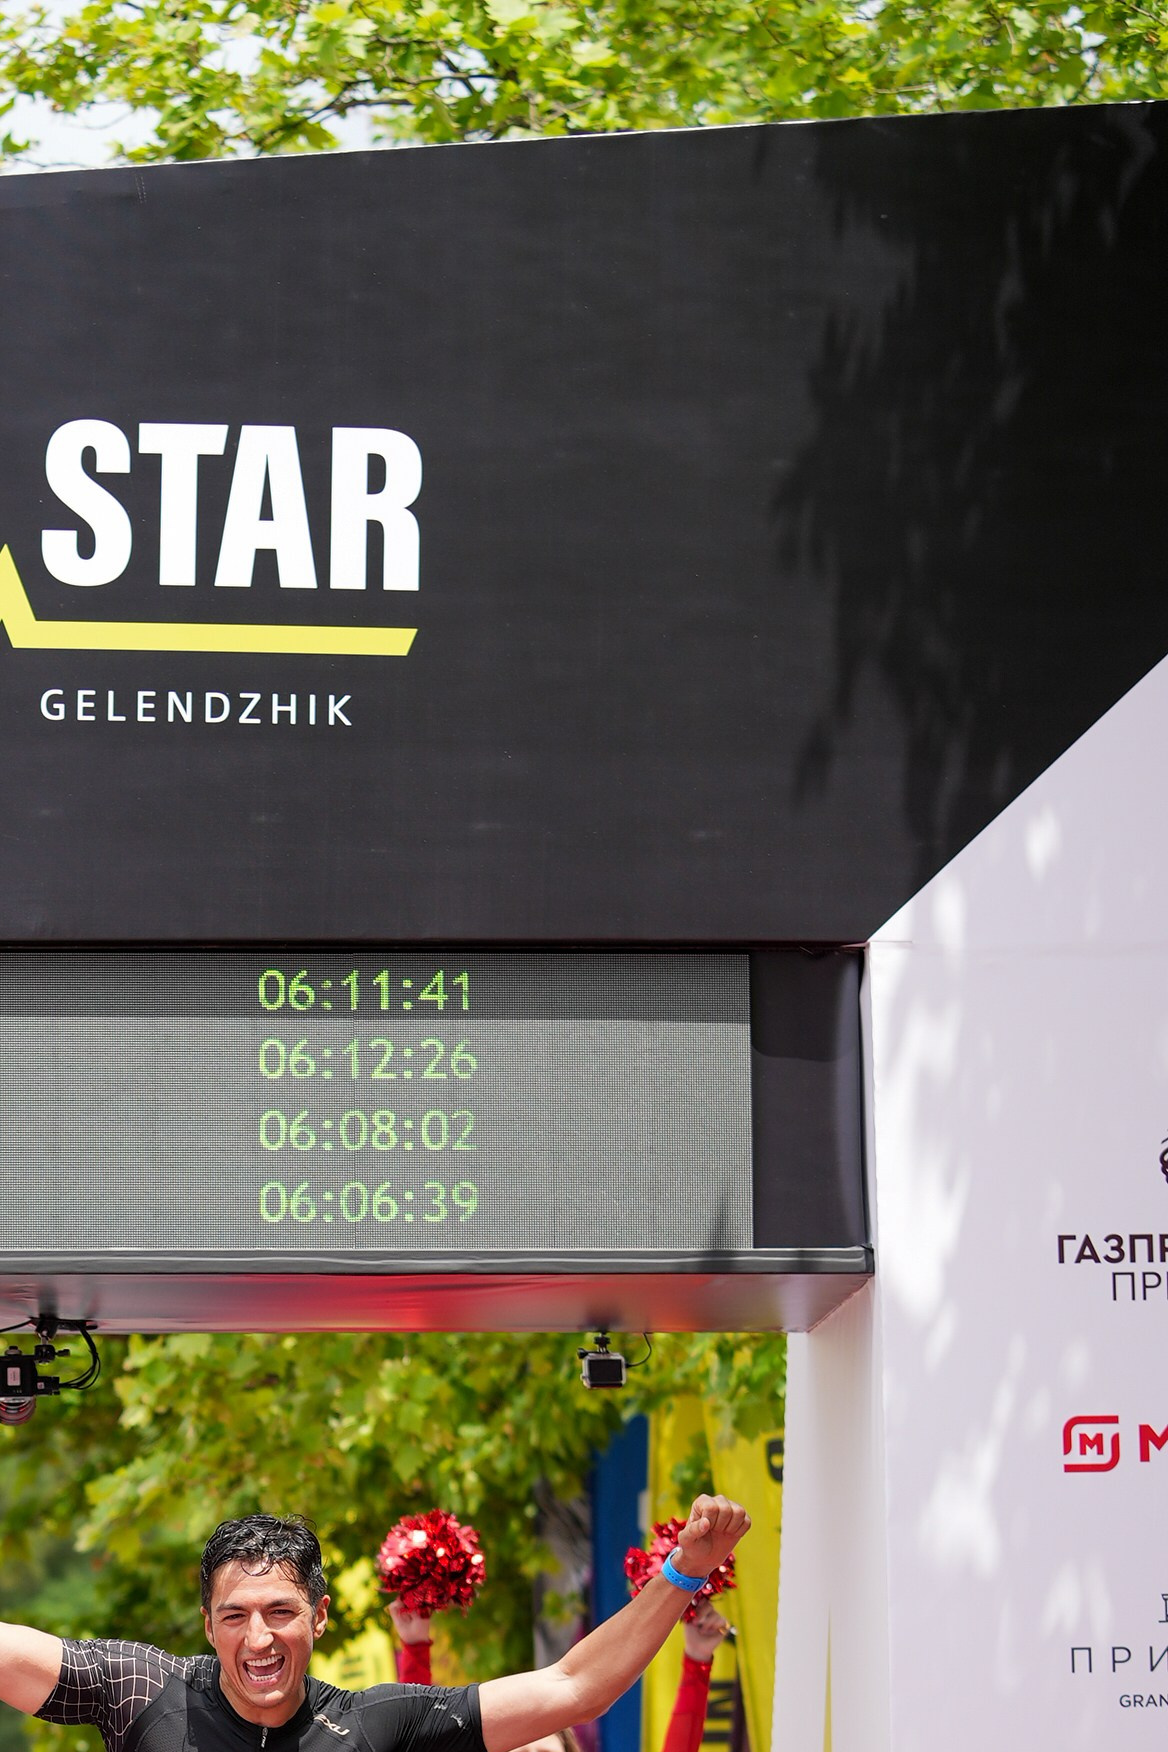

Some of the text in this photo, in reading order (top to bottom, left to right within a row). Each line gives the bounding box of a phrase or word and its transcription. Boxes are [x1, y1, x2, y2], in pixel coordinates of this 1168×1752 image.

[40, 418, 422, 592] STAR
[40, 688, 353, 726] GELENDZHIK
[258, 968, 470, 1010] 06:11:41
[258, 1037, 478, 1079] 06:12:26
[259, 1108, 478, 1151] 06:08:02
[259, 1180, 479, 1223] 06:06:39
